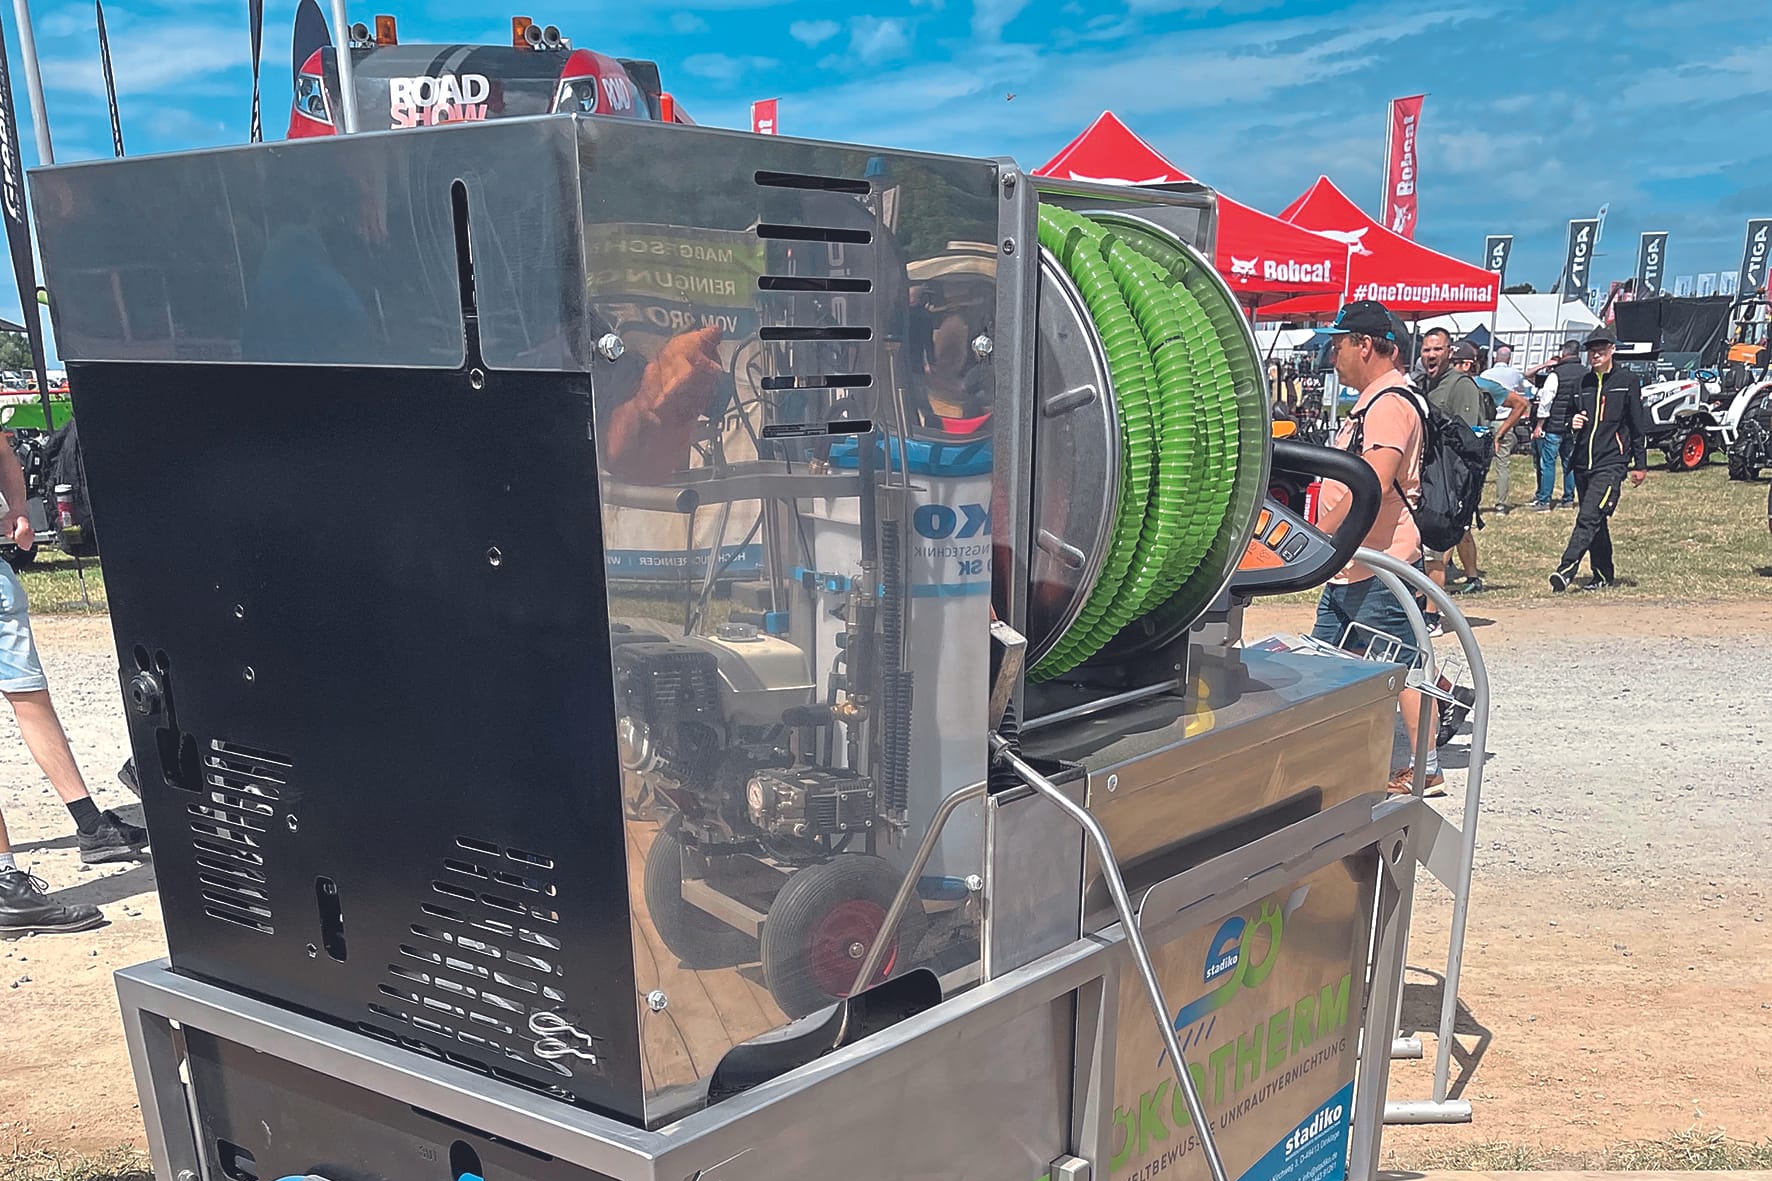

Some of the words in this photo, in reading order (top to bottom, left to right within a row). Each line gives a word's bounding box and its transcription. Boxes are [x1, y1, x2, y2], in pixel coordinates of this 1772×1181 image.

[389, 74, 490, 107] ROAD
[390, 103, 488, 129] SHOW
[1396, 114, 1415, 197] Bobcat
[1264, 259, 1331, 283] Bobcat
[1572, 226, 1590, 288] STIGA
[1644, 238, 1661, 292] STIGA
[1747, 225, 1768, 286] STIGA
[1353, 282, 1493, 303] #OneToughAnimal
[1206, 954, 1238, 979] stadiko
[1220, 1038, 1347, 1129] UNKRAUTVERNICHTUNG
[1285, 1104, 1343, 1156] stadiko
